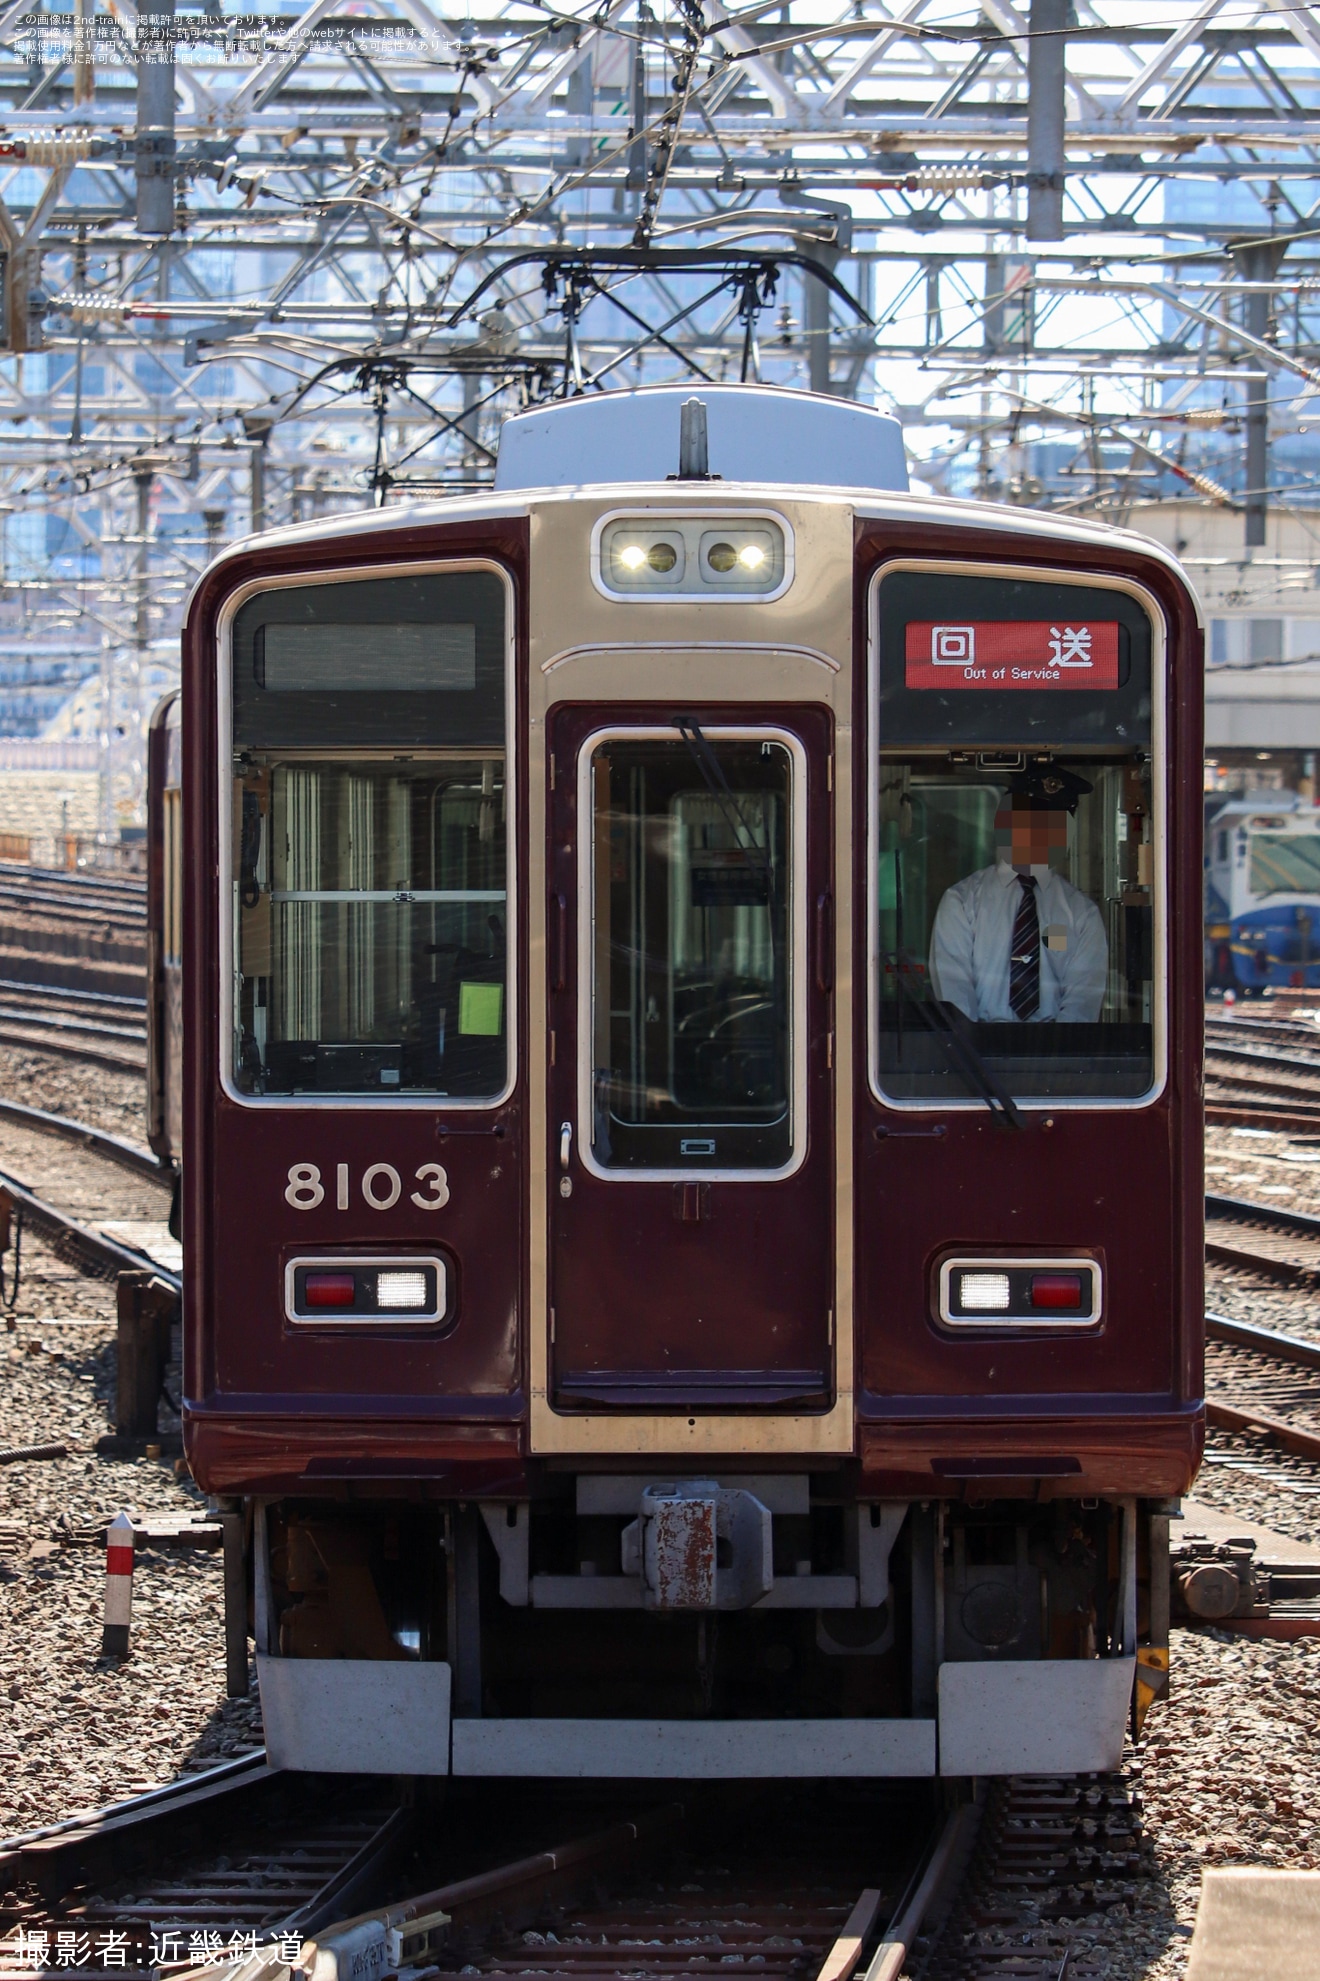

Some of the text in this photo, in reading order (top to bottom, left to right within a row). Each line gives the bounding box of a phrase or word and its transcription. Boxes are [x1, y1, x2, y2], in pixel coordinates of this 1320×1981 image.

[964, 667, 1060, 680] Out of Service
[284, 1162, 450, 1210] 8103
